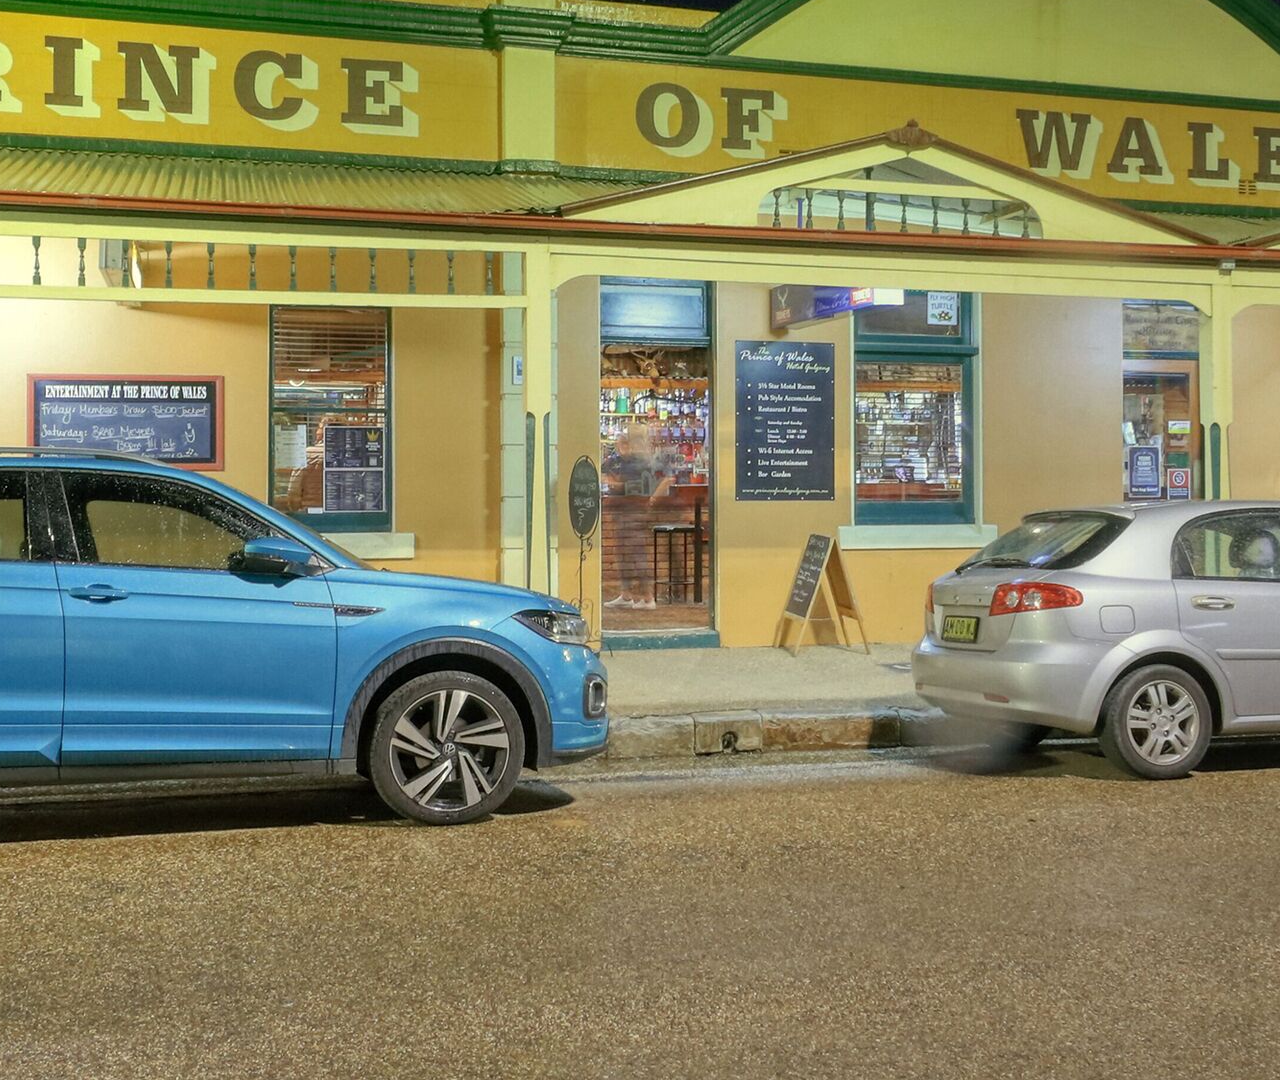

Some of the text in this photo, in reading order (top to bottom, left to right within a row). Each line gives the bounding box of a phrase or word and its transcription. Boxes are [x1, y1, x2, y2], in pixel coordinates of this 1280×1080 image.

[635, 82, 788, 159] OF
[740, 350, 814, 366] Prince of Wales
[45, 385, 207, 399] ENTERTAINMENT AT THE PRINCE OF WALES
